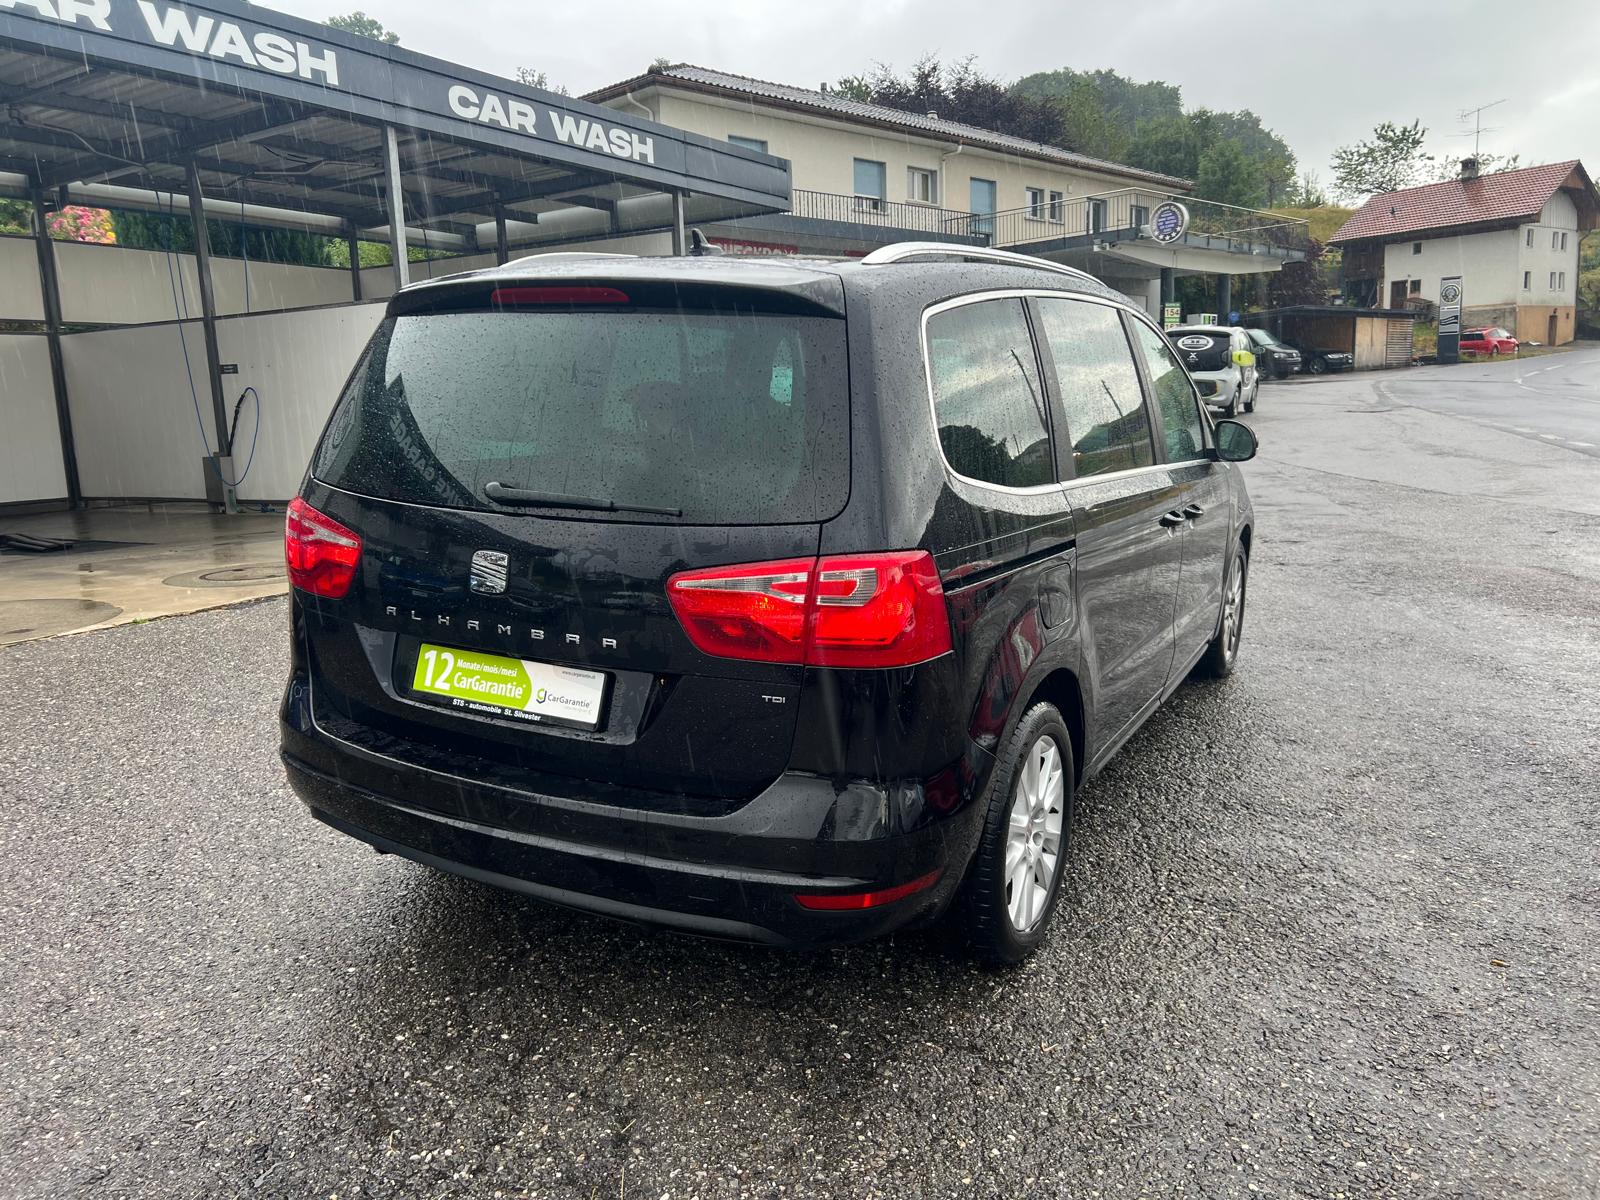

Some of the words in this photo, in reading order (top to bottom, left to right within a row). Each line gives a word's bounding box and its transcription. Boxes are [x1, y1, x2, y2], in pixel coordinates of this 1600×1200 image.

[136, 0, 339, 86] WASH
[448, 85, 537, 135] CAR
[548, 110, 655, 164] WASH
[386, 605, 617, 649] ALHAMBRA
[424, 650, 454, 691] 12
[456, 658, 518, 677] Monate/mois/mesi
[453, 698, 465, 707] STS
[468, 702, 502, 714] automobile
[504, 708, 513, 716] St.
[513, 710, 542, 721] Silvester
[761, 695, 786, 704] TDI
